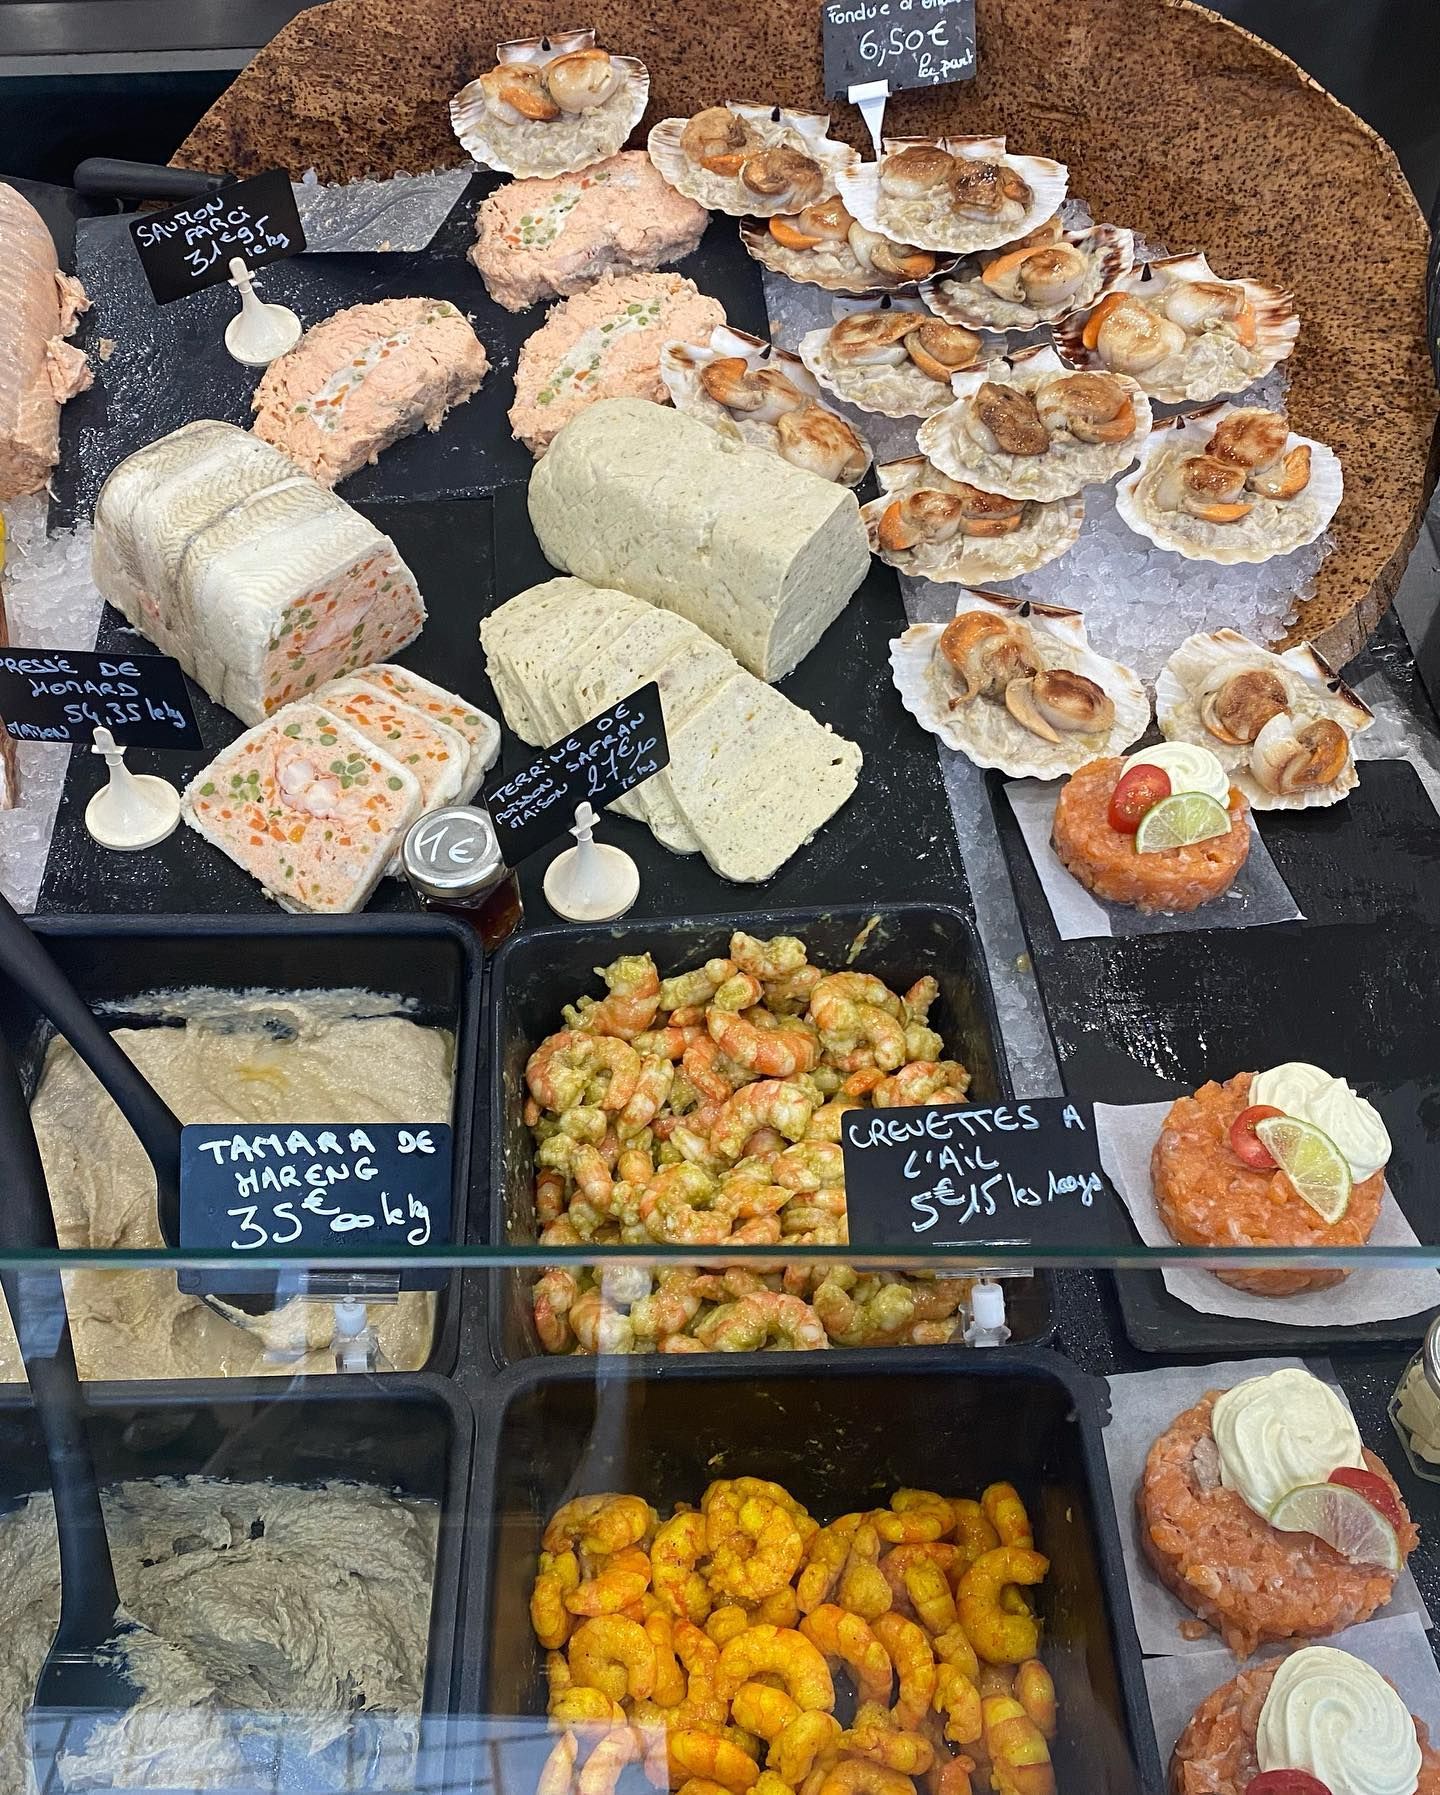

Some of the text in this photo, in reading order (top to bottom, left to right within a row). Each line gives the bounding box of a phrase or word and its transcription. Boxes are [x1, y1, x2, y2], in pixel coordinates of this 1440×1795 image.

[860, 20, 949, 67] 6,50€
[940, 48, 974, 78] part
[99, 662, 141, 677] DE
[28, 679, 139, 698] HOMARD
[63, 702, 142, 726] 54,35
[596, 703, 630, 732] DE
[565, 712, 645, 773] SAFRAN
[849, 1104, 1086, 1148] CREVETTES A
[198, 1129, 436, 1165] TAMARA DE
[235, 1156, 379, 1198] HARENG
[1006, 1172, 1042, 1208] les
